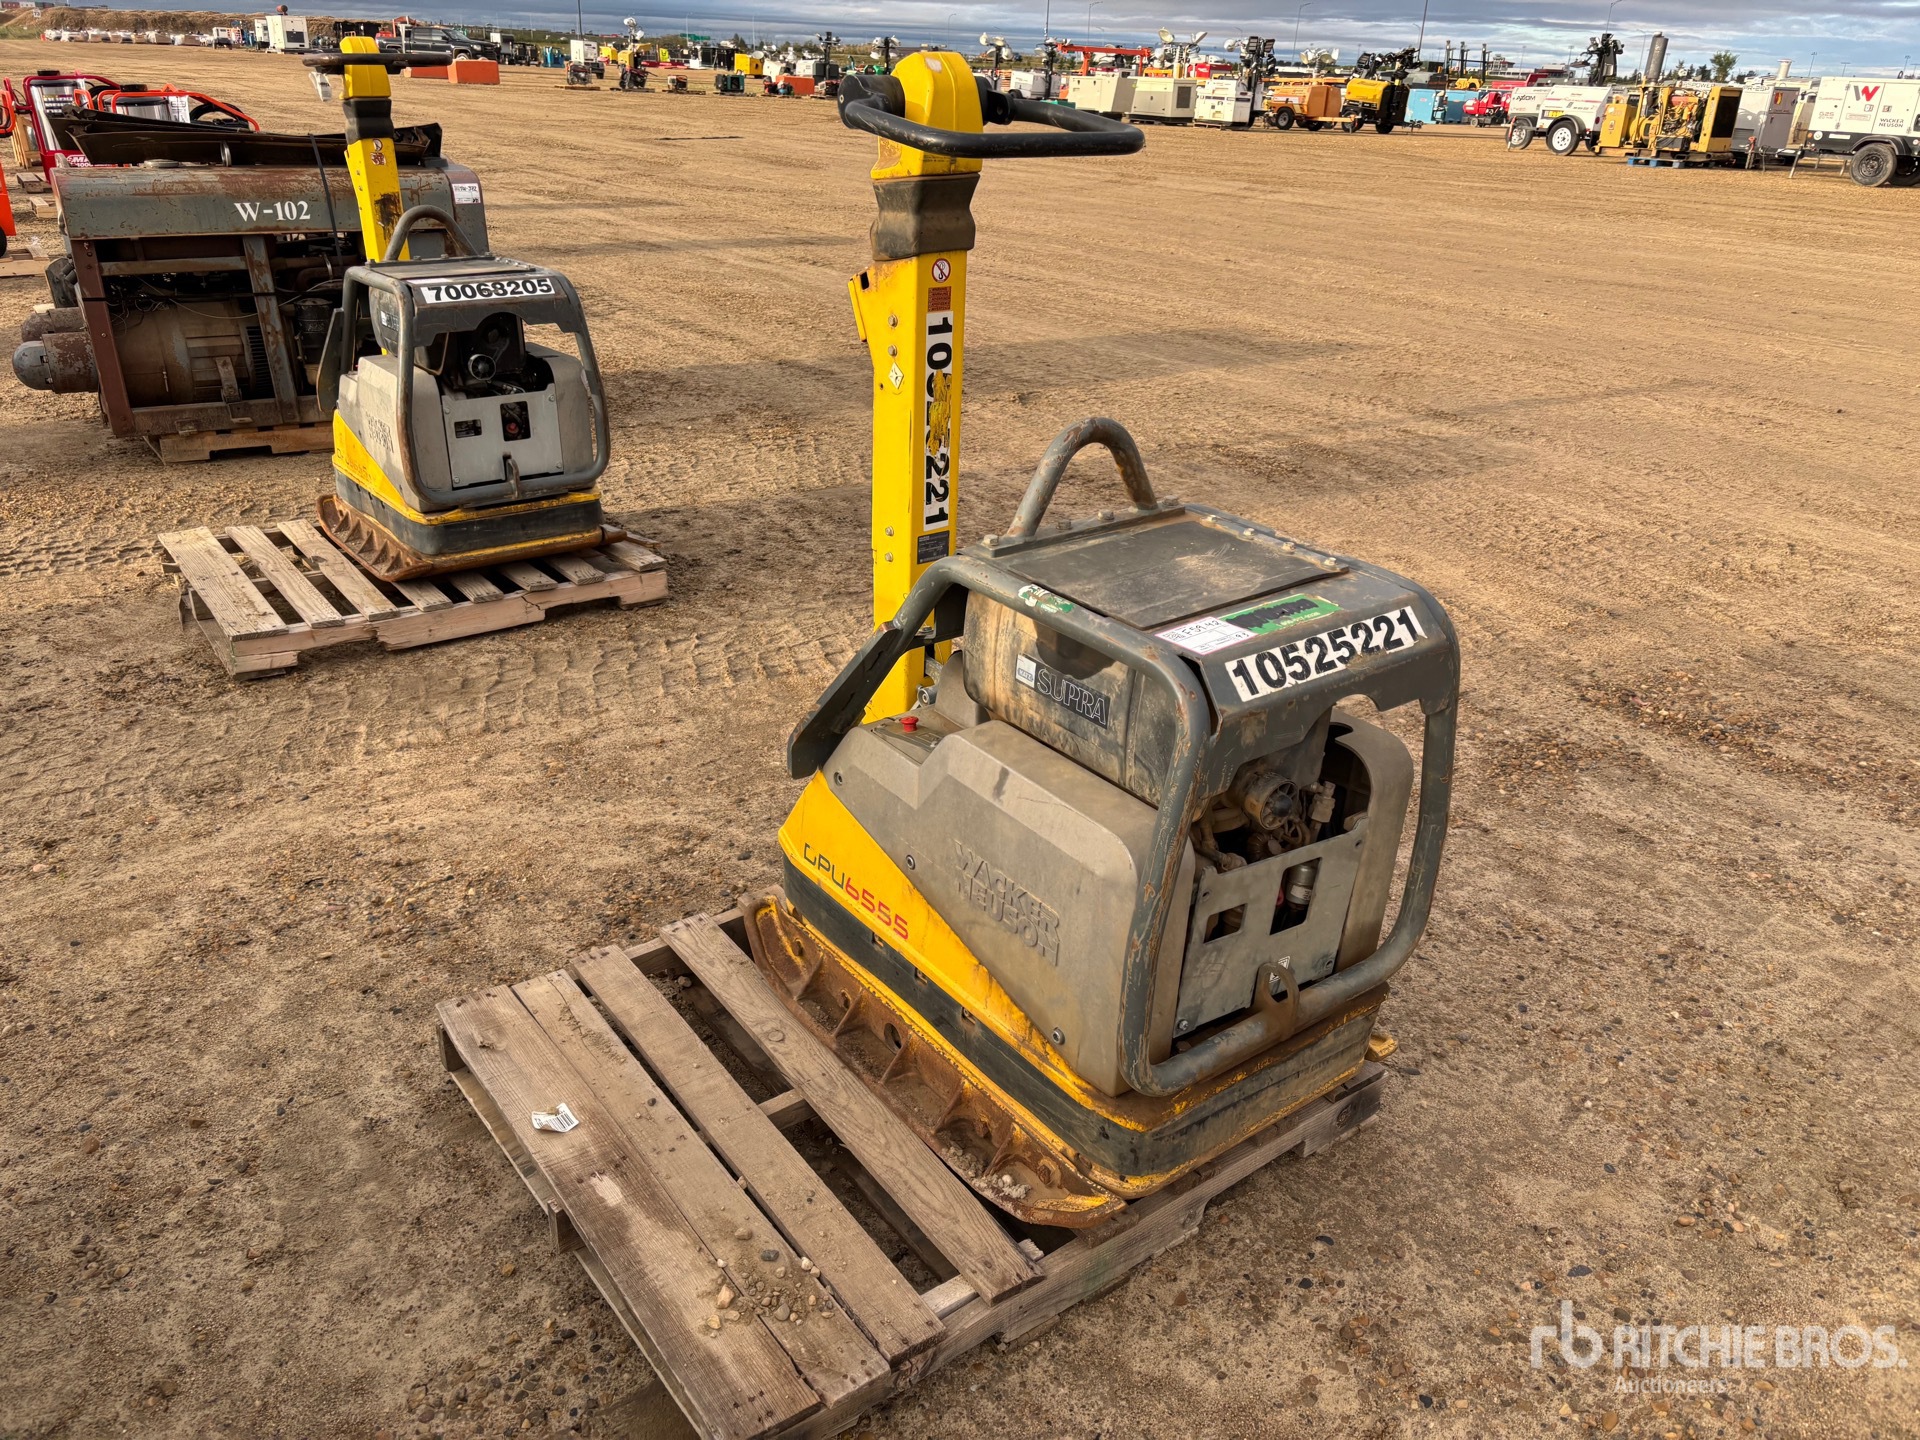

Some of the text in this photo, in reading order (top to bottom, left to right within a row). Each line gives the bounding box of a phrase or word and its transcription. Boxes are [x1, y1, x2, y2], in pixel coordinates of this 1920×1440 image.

[233, 200, 311, 222] W-102
[428, 279, 552, 301] 70068205
[1233, 608, 1420, 696] 10525221
[1037, 669, 1107, 726] SUPRA
[954, 839, 1061, 934] WACKER
[957, 875, 1061, 967] NEUSON
